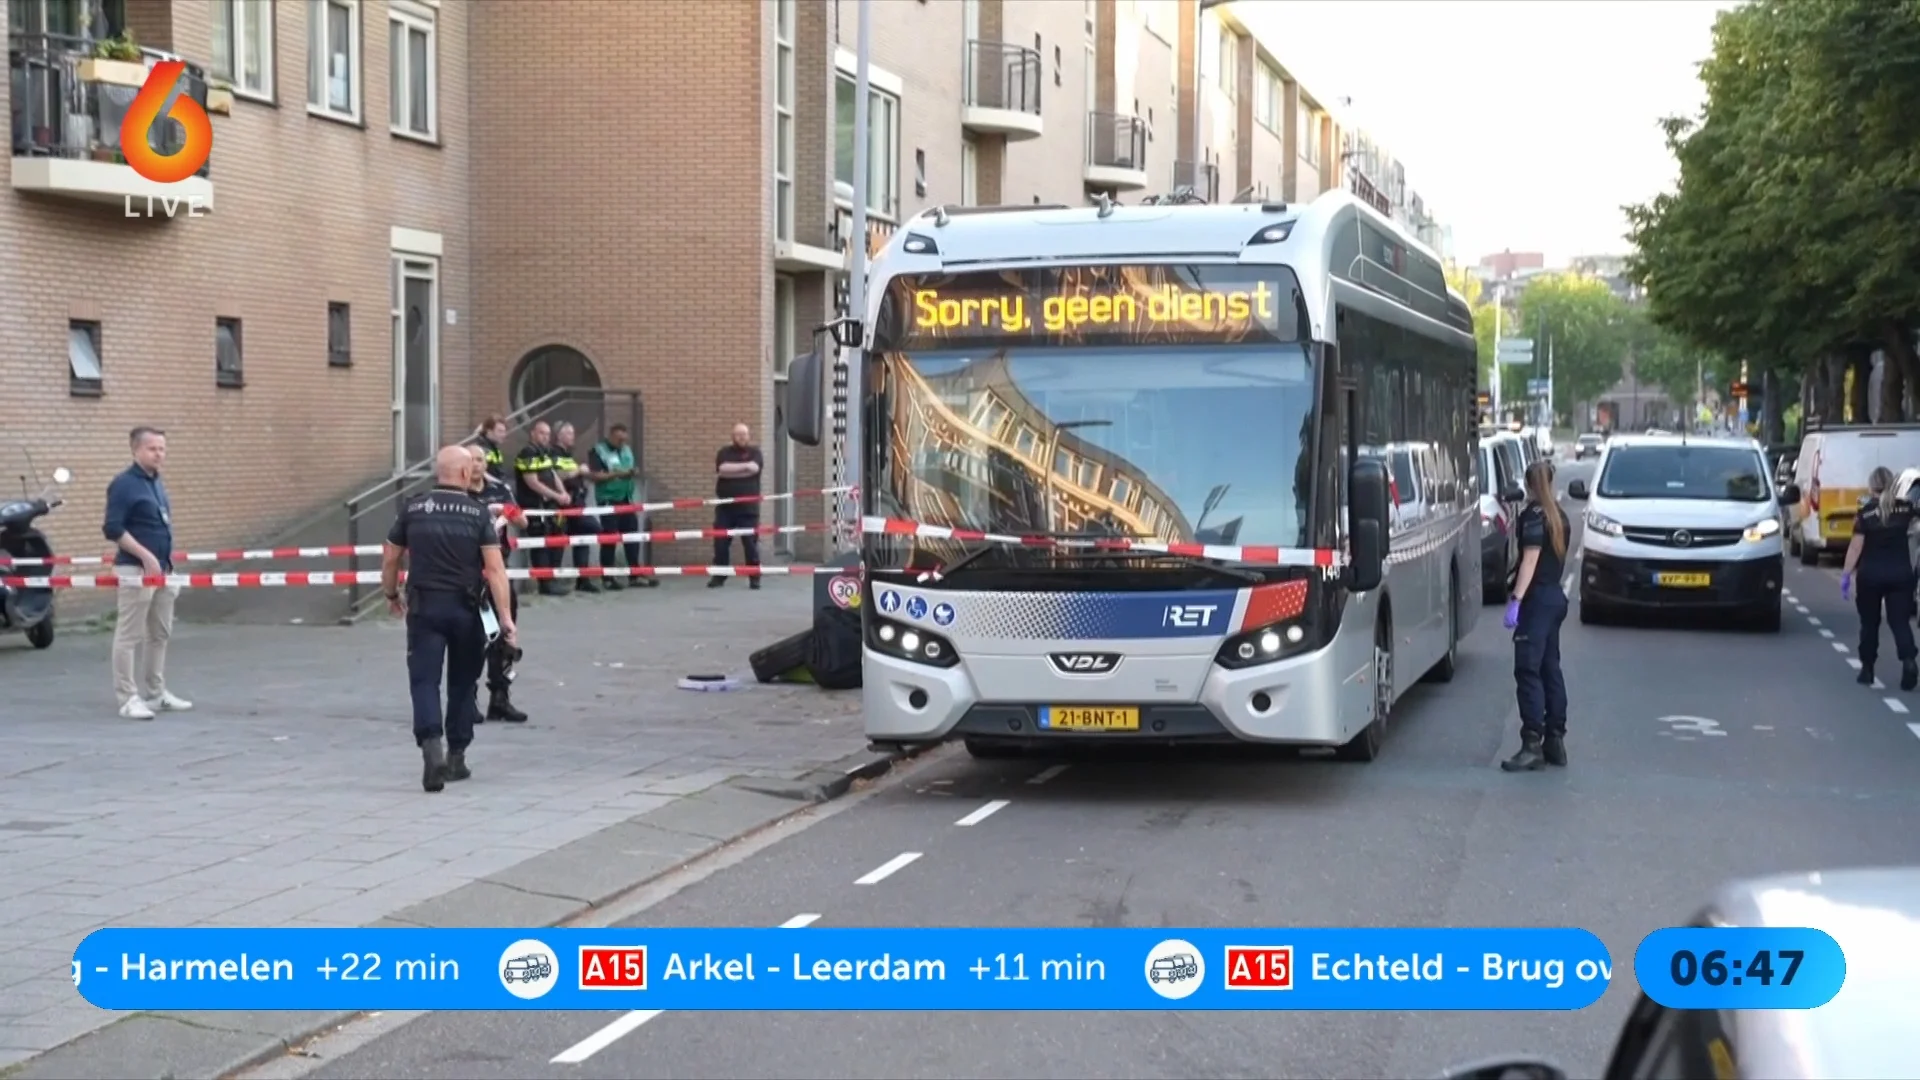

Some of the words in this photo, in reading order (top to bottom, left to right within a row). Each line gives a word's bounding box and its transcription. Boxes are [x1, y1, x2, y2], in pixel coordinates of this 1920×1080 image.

[916, 290, 1031, 331] Sorry,
[1044, 295, 1136, 329] geen
[1149, 281, 1272, 320] dienst
[837, 585, 853, 598] 30
[1168, 604, 1218, 627] RET
[1059, 656, 1109, 669] VDL
[1059, 710, 1127, 726] 21-BNT-1
